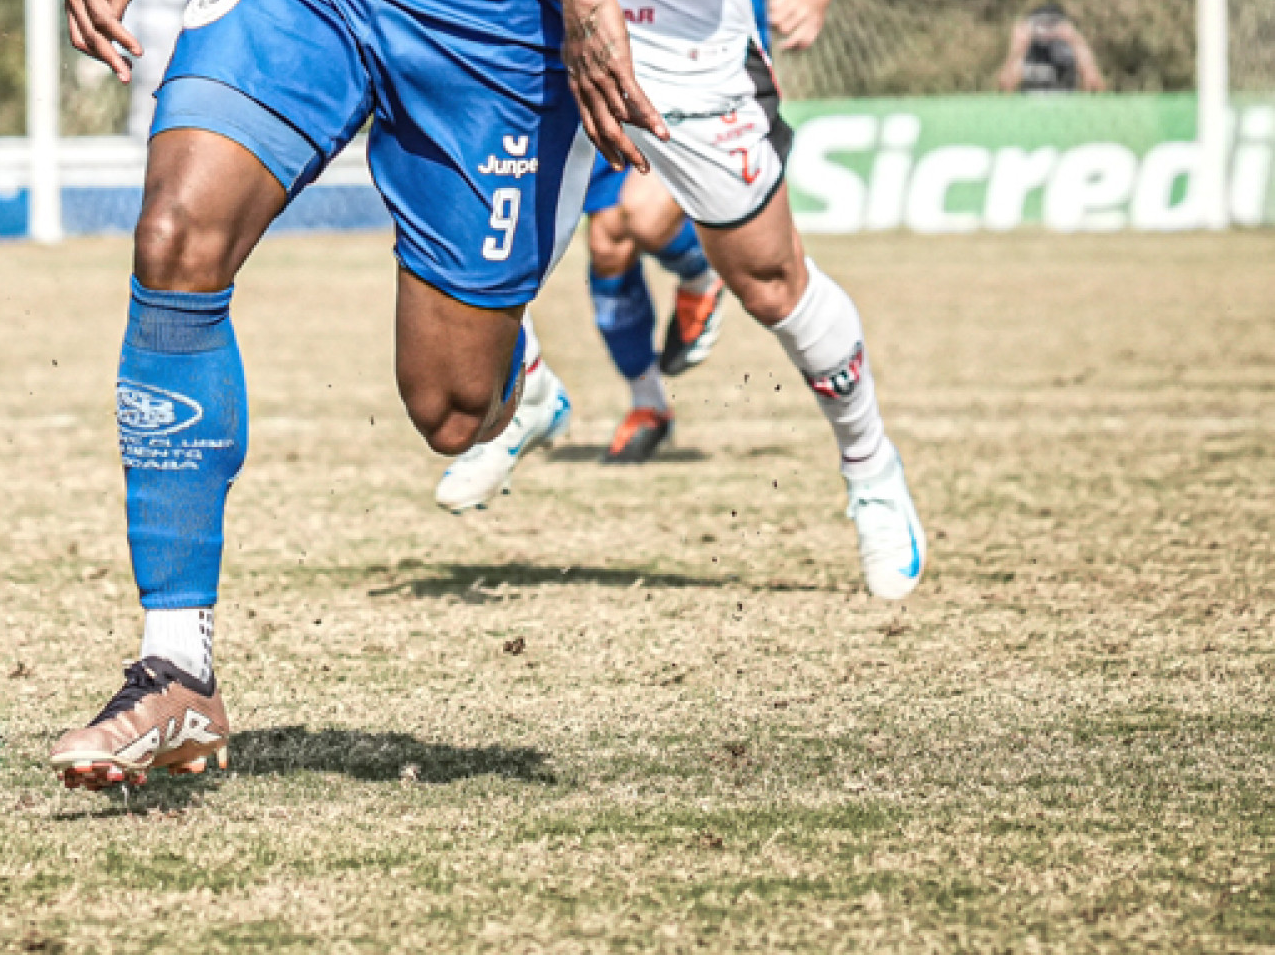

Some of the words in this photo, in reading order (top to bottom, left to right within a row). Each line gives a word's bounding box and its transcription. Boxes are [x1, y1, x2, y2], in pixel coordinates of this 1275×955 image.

[477, 154, 540, 179] Junpe
[786, 112, 1275, 233] Sicredi
[482, 187, 523, 261] 9
